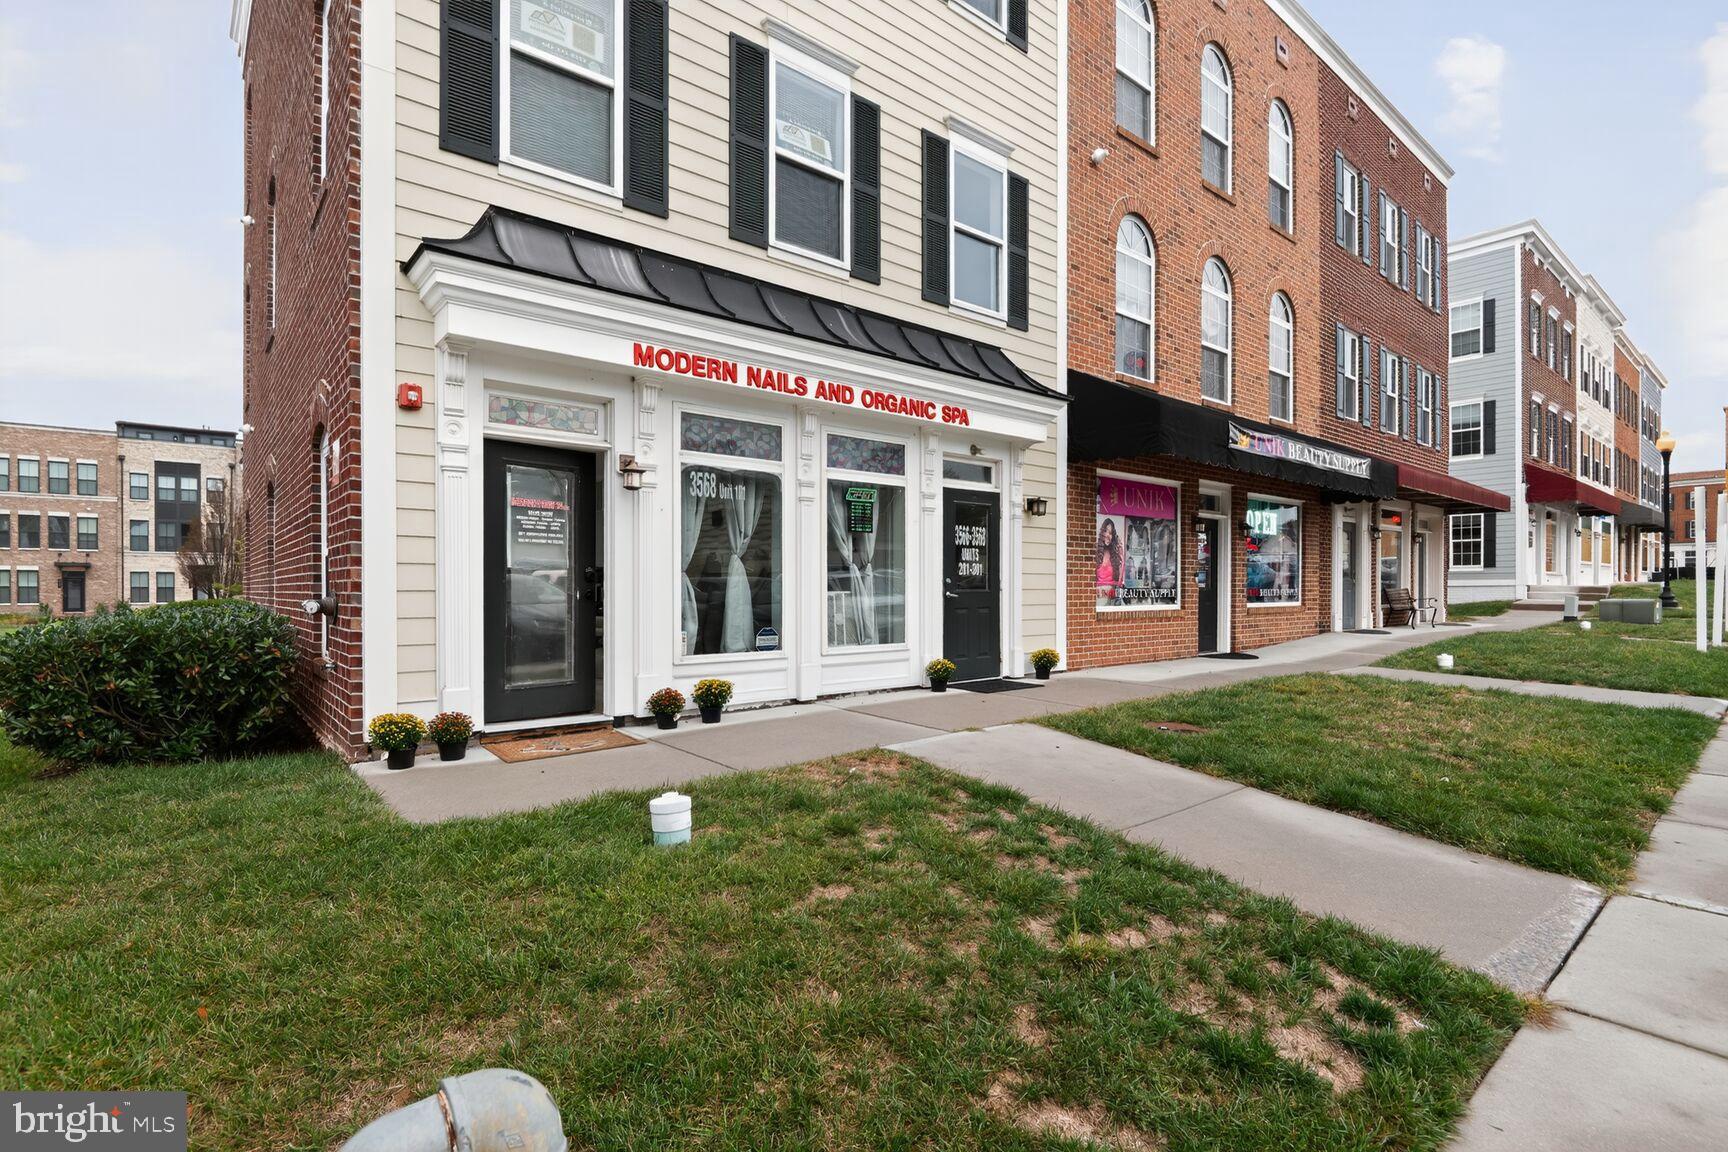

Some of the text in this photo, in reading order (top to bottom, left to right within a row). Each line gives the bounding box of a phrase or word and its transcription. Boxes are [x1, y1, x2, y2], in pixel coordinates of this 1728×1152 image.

[633, 342, 970, 426] MODERN NAILS AND ORGANIC SPA
[1288, 442, 1331, 466] BEAUTY
[1333, 455, 1368, 476] SUPPLY
[689, 471, 717, 498] 3568
[719, 482, 733, 499] Unit
[1124, 487, 1164, 511] UNIK
[1246, 510, 1278, 535] OPEN
[961, 548, 979, 561] UNITS
